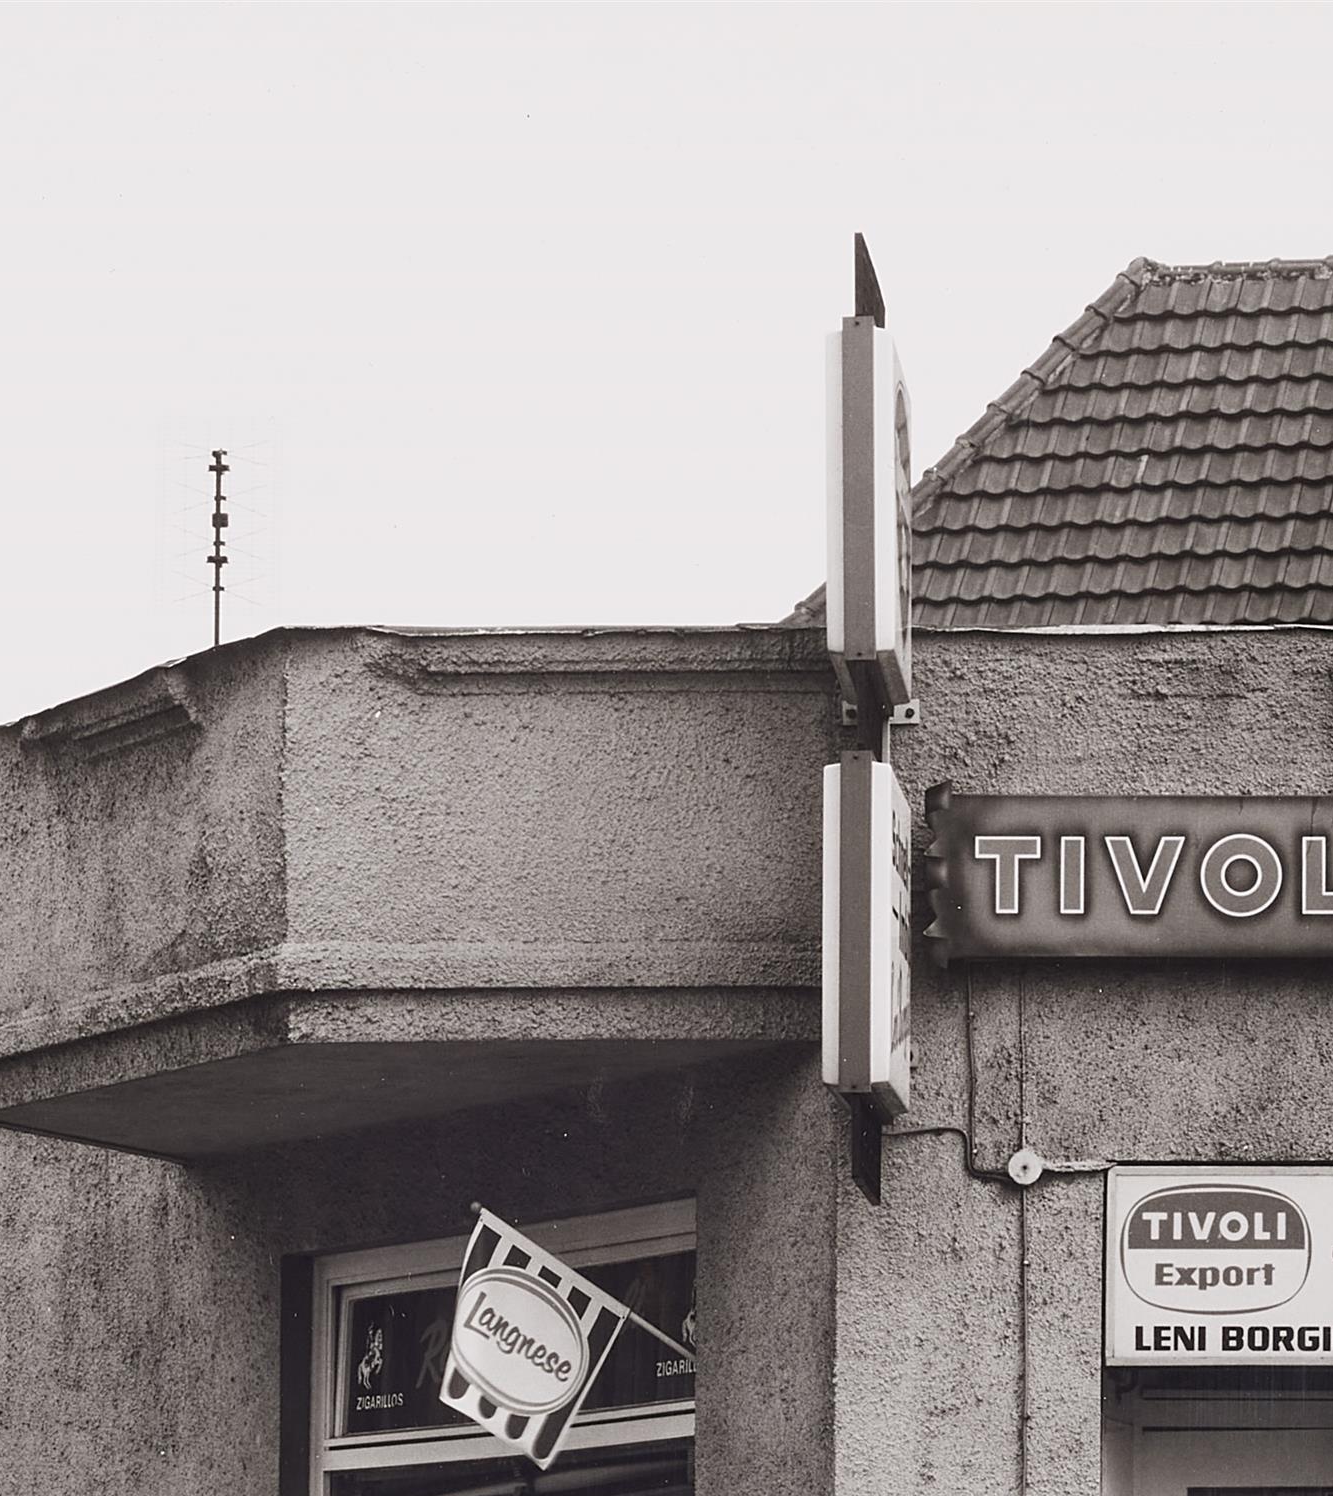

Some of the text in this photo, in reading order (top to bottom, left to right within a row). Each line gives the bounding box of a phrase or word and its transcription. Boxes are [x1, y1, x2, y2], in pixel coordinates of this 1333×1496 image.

[1140, 1208, 1290, 1242] TIVOLI
[1153, 1261, 1276, 1290] Export
[461, 1290, 572, 1383] Langnese
[1133, 1325, 1208, 1353] LENI
[356, 1392, 405, 1411] ZIGARILLOS
